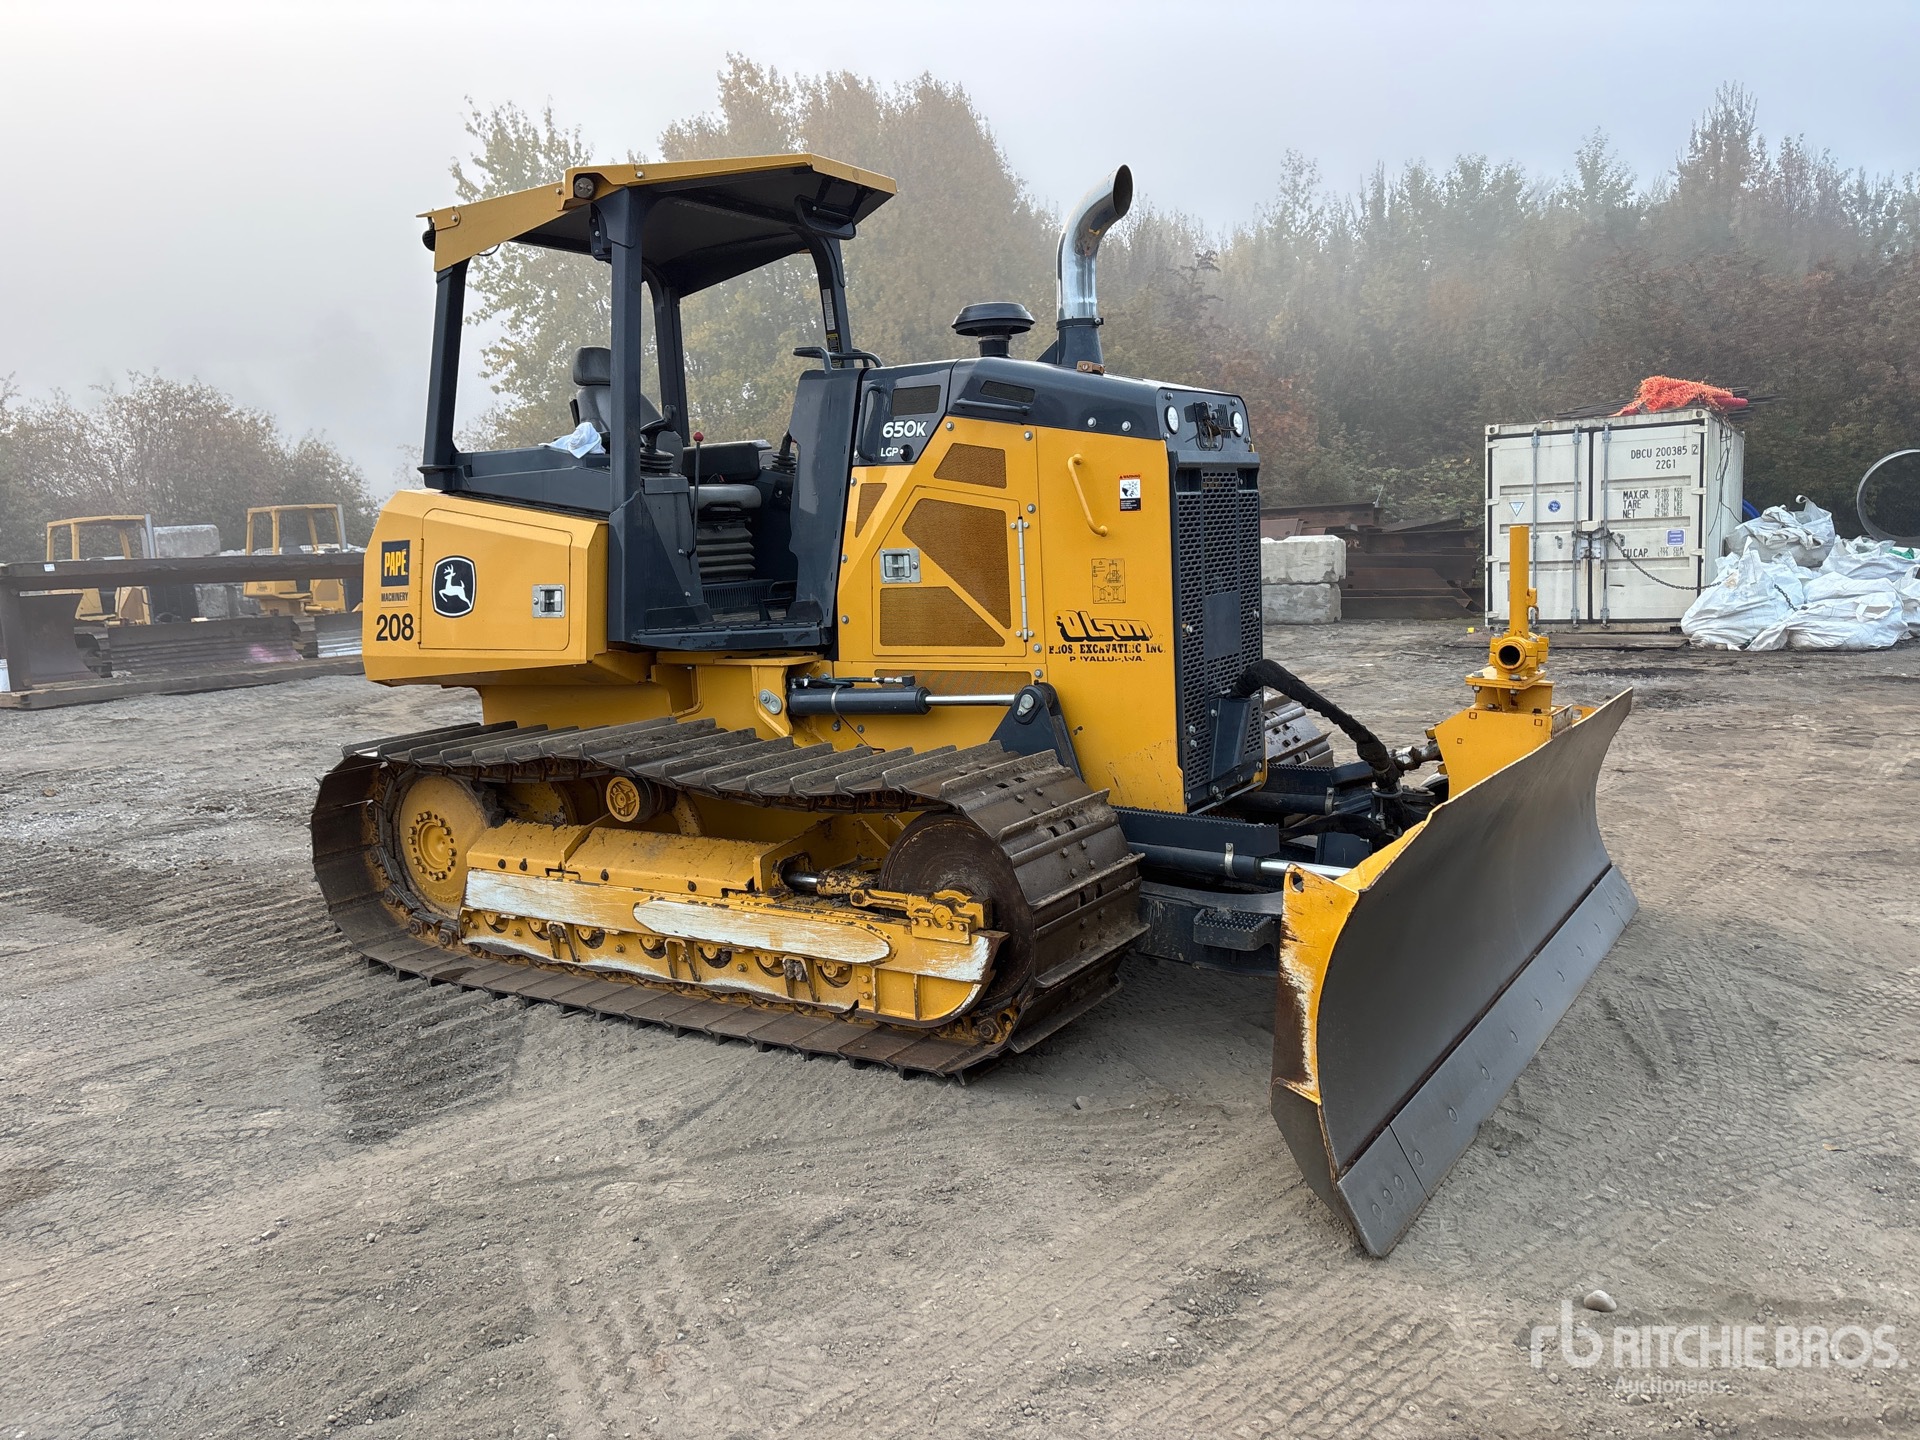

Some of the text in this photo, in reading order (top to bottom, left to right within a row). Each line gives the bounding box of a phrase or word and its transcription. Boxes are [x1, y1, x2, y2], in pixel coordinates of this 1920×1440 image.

[882, 420, 927, 438] 650K
[880, 447, 899, 457] LGP
[1631, 444, 1699, 459] DBCU 200385 2
[1656, 459, 1676, 470] 22G1
[1623, 500, 1641, 509] TARE
[1623, 509, 1636, 518] NET
[381, 592, 408, 602] MACHINERY
[376, 613, 414, 641] 208
[1056, 610, 1153, 642] Olson
